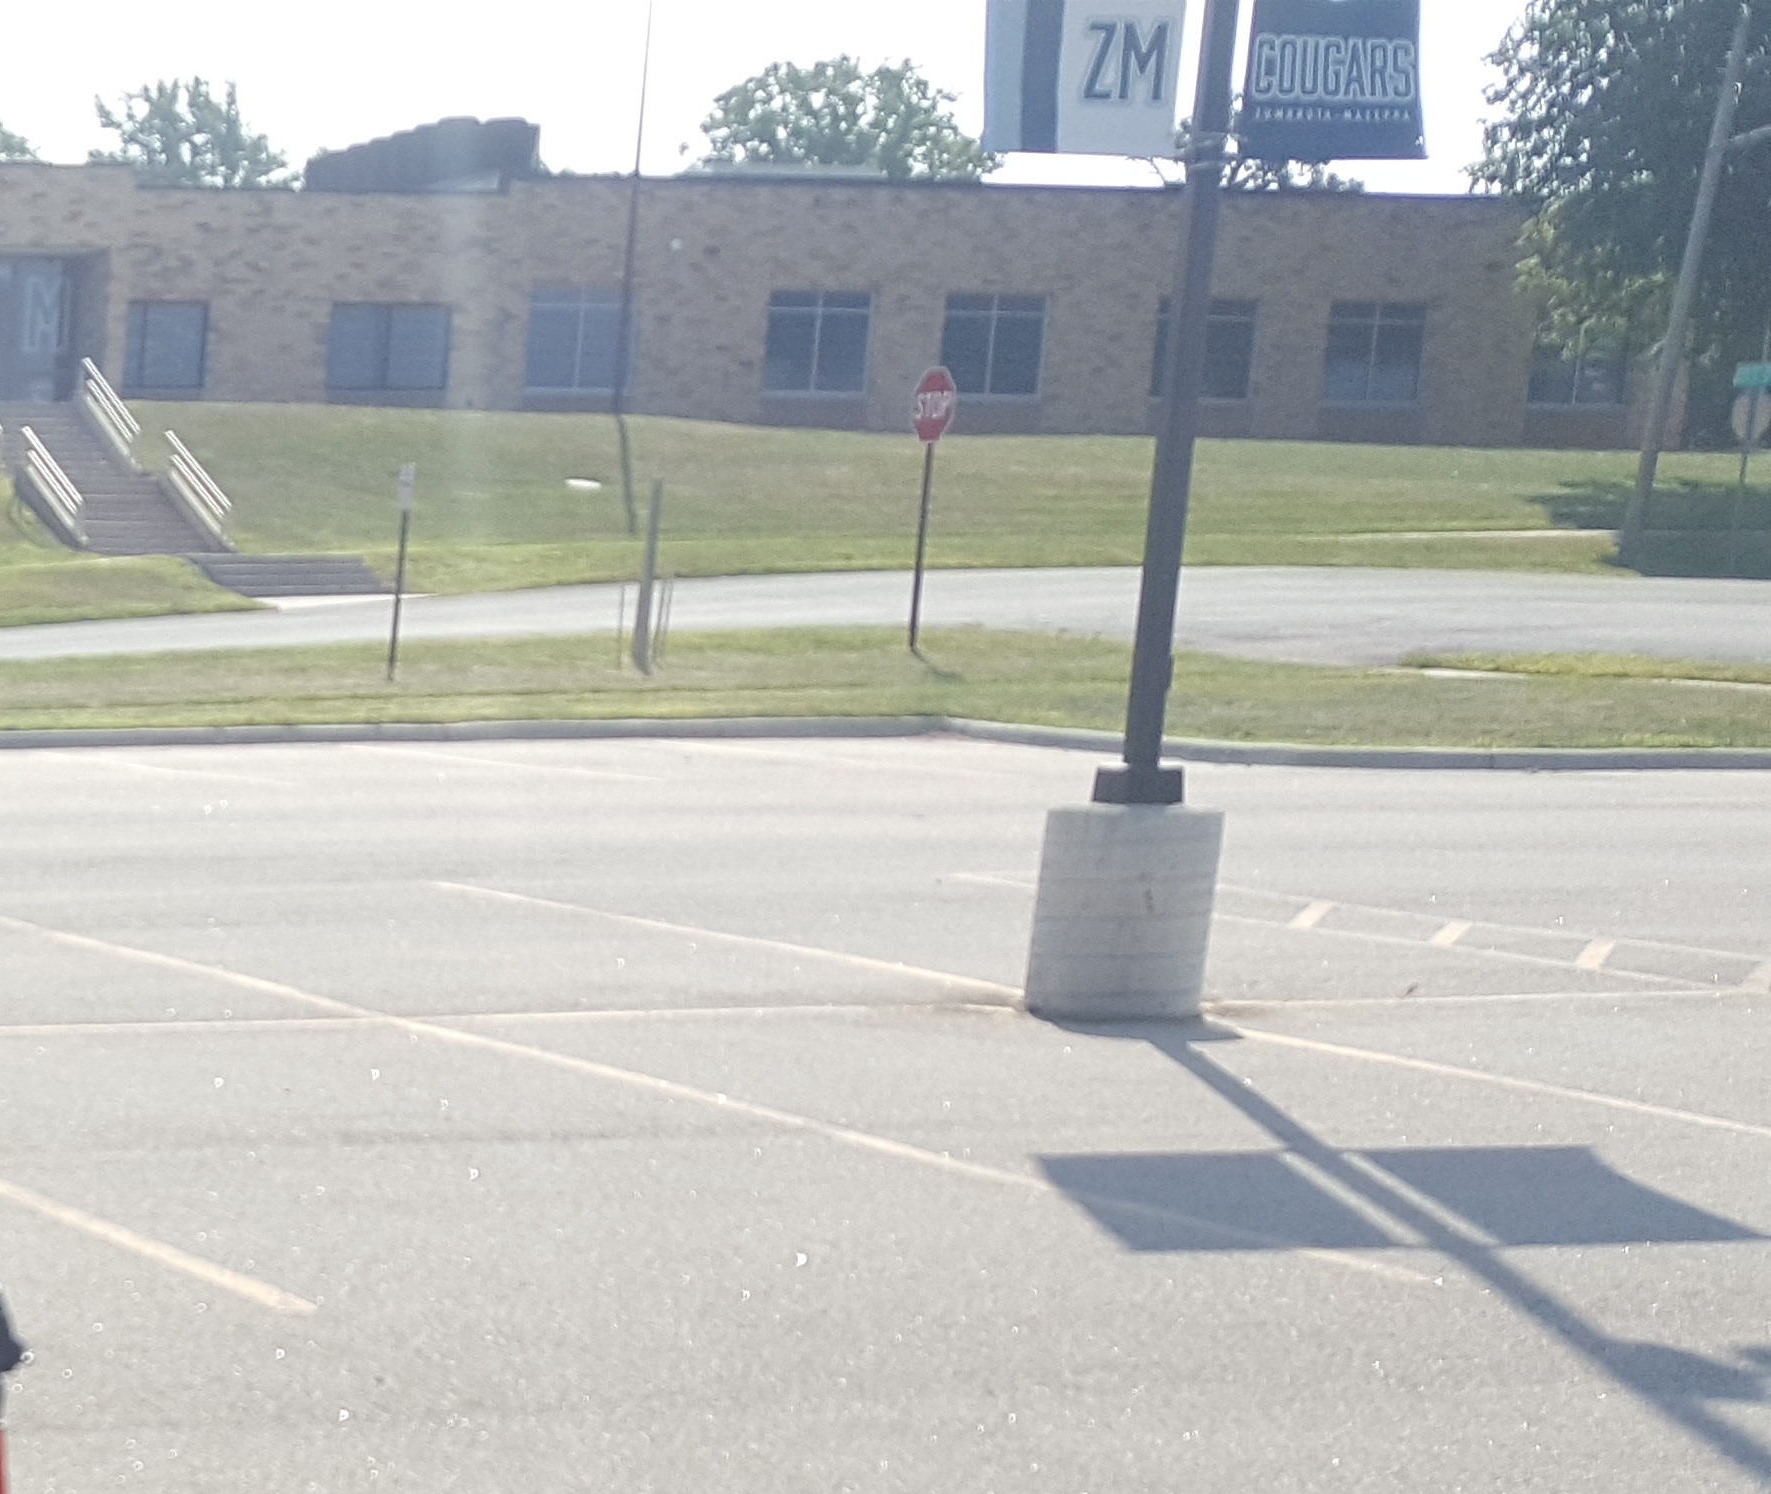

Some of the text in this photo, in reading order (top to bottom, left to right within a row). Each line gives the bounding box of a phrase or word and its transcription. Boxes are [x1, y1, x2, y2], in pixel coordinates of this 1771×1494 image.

[1084, 20, 1170, 100] ZM
[1254, 34, 1415, 99] COUGARS
[915, 390, 955, 419] STOP
